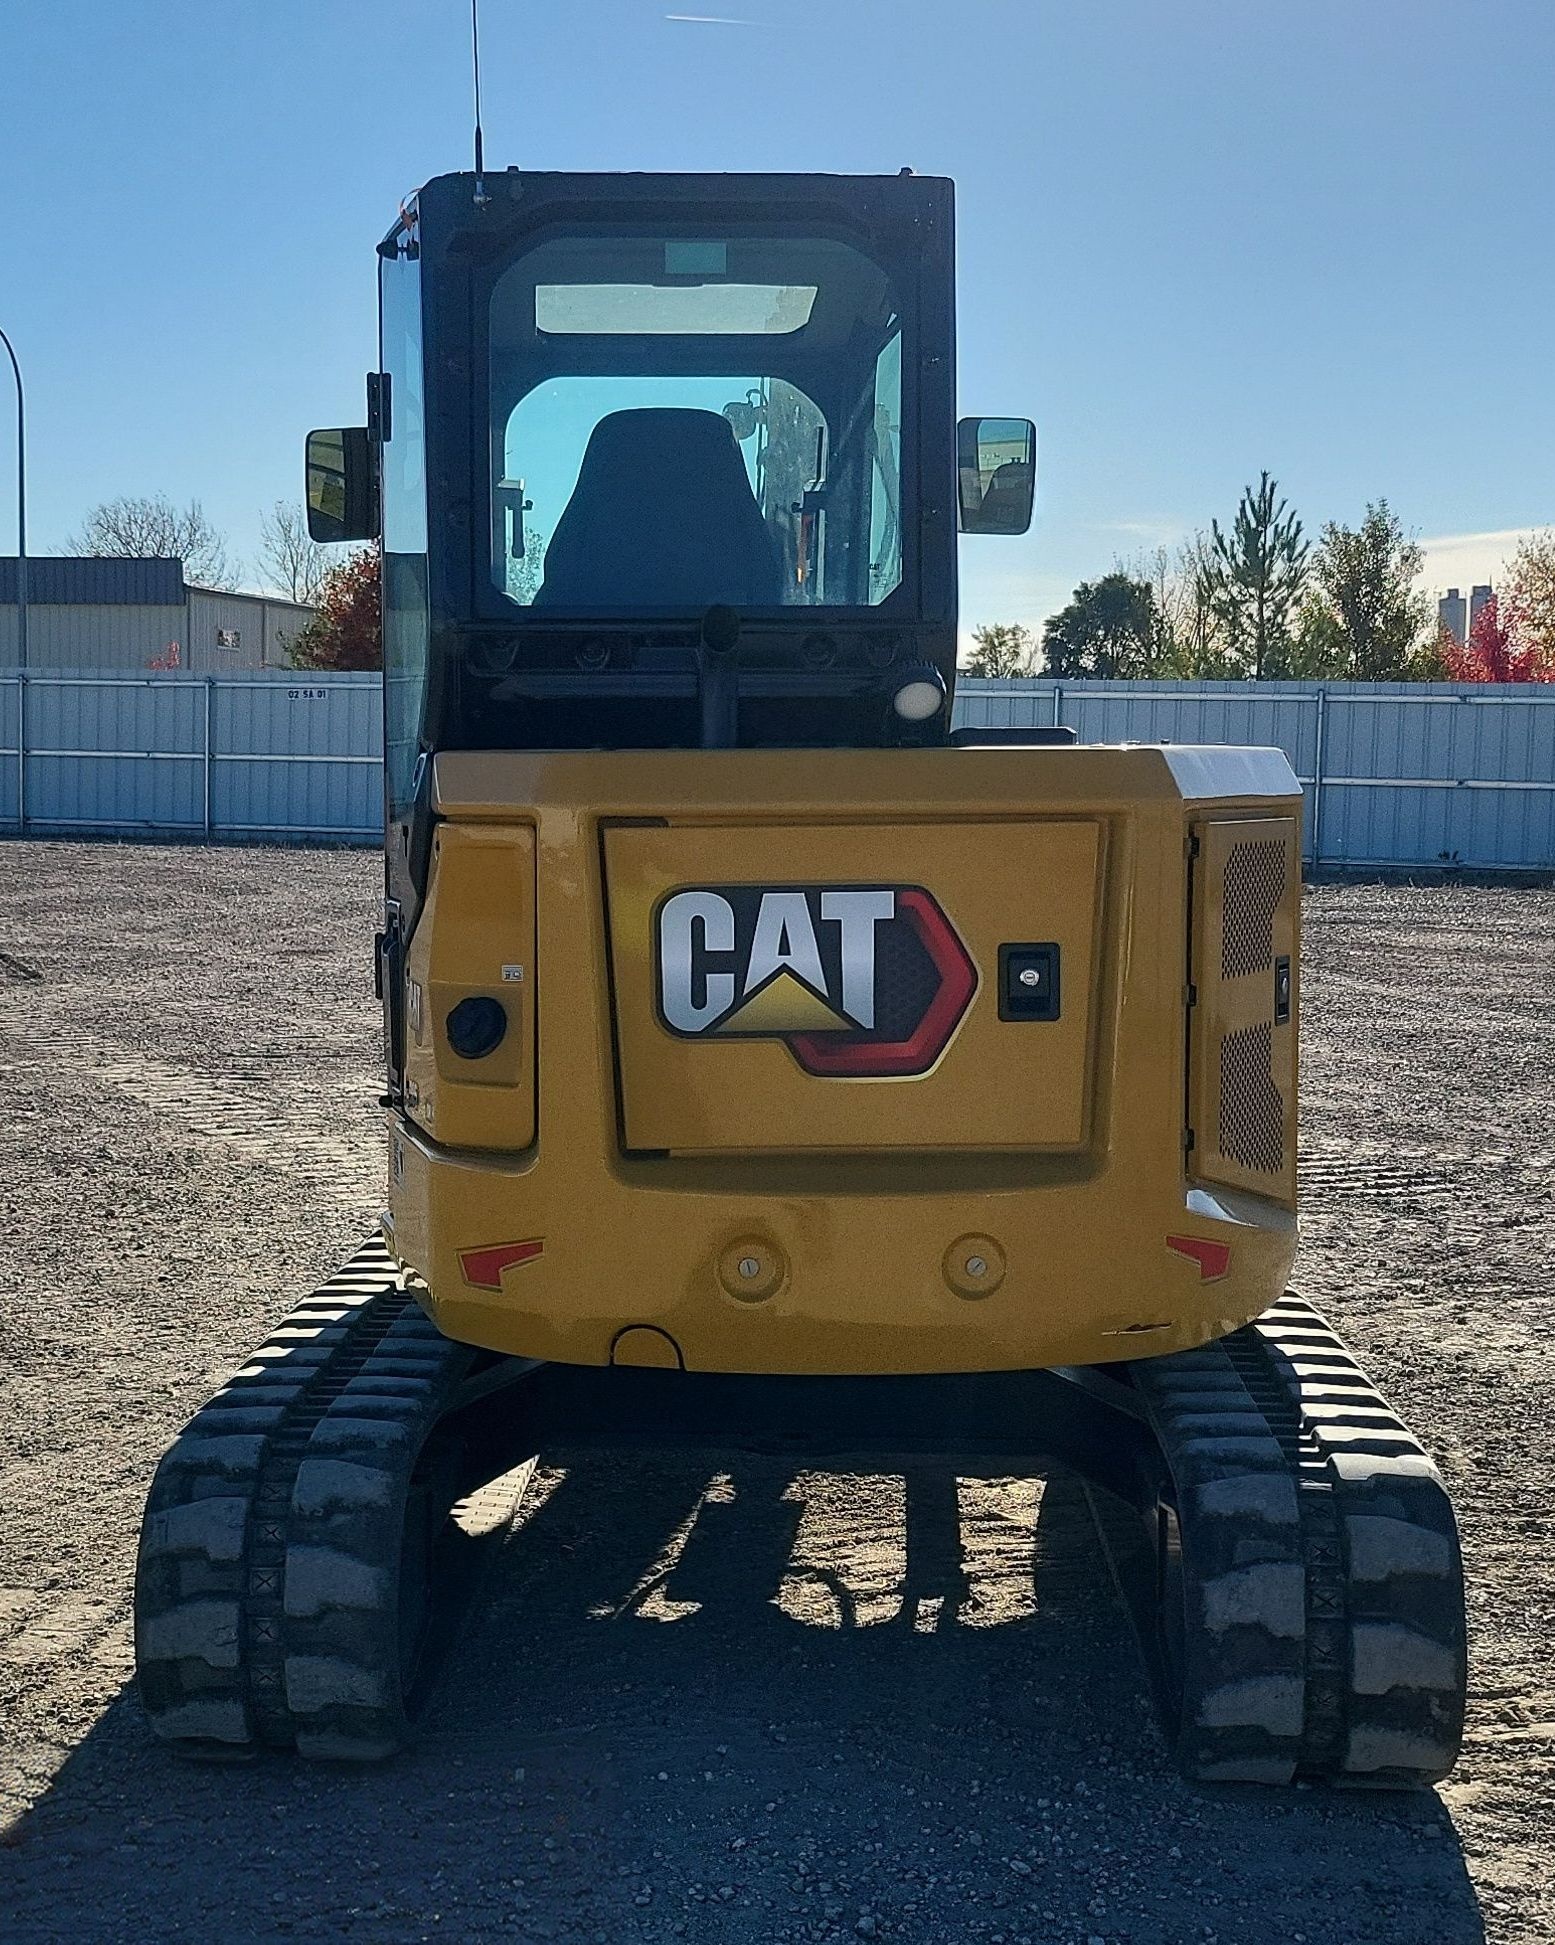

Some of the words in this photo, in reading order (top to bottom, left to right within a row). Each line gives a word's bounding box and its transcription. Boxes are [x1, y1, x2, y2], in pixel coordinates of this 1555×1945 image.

[288, 690, 299, 698] 02
[303, 690, 314, 698] SA
[660, 890, 894, 1031] CAT
